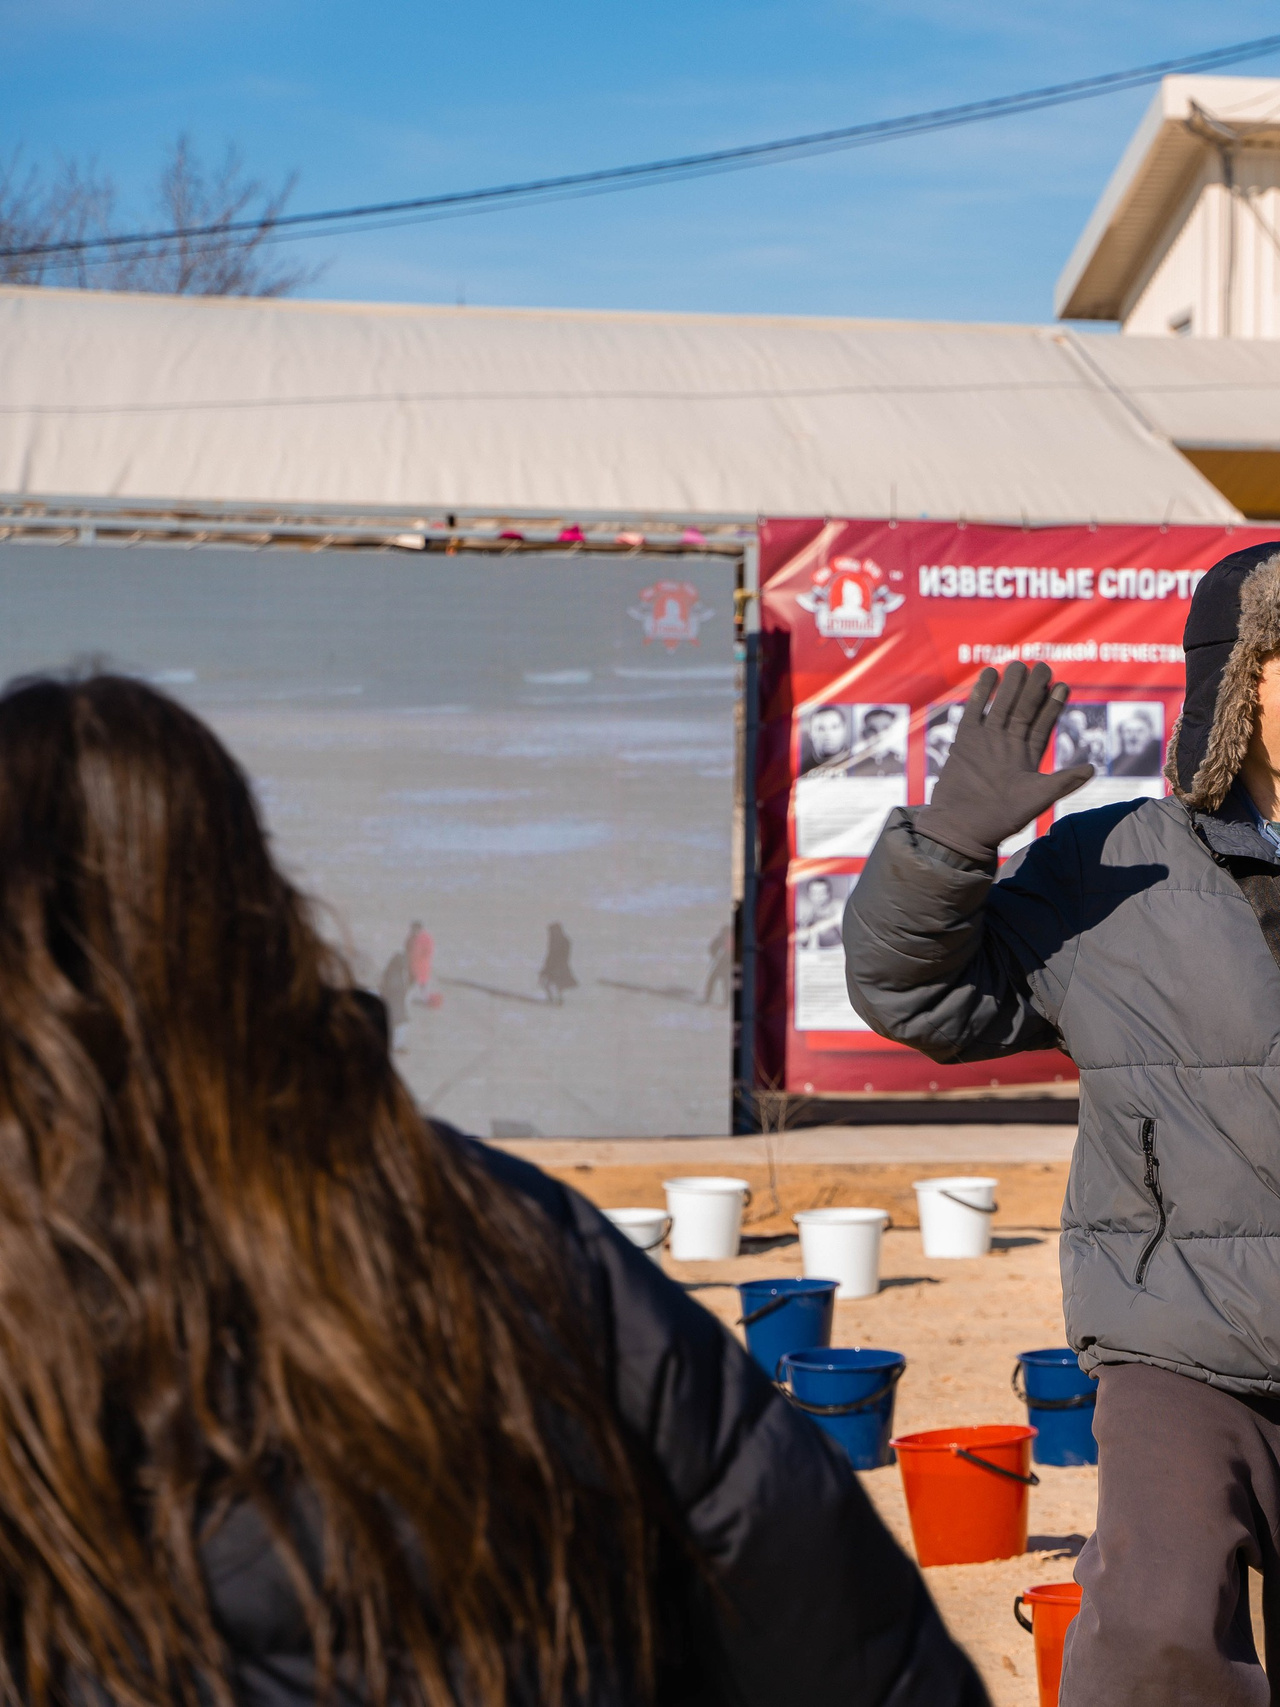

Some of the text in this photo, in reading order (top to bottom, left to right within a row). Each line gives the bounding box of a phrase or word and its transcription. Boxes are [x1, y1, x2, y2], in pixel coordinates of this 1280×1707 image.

[918, 565, 1094, 599] ИЗВЕСТНЫЕ
[958, 644, 971, 663] В
[973, 644, 1019, 664] ГОДЫ
[1021, 639, 1098, 662] ВЕЛИКОЙ
